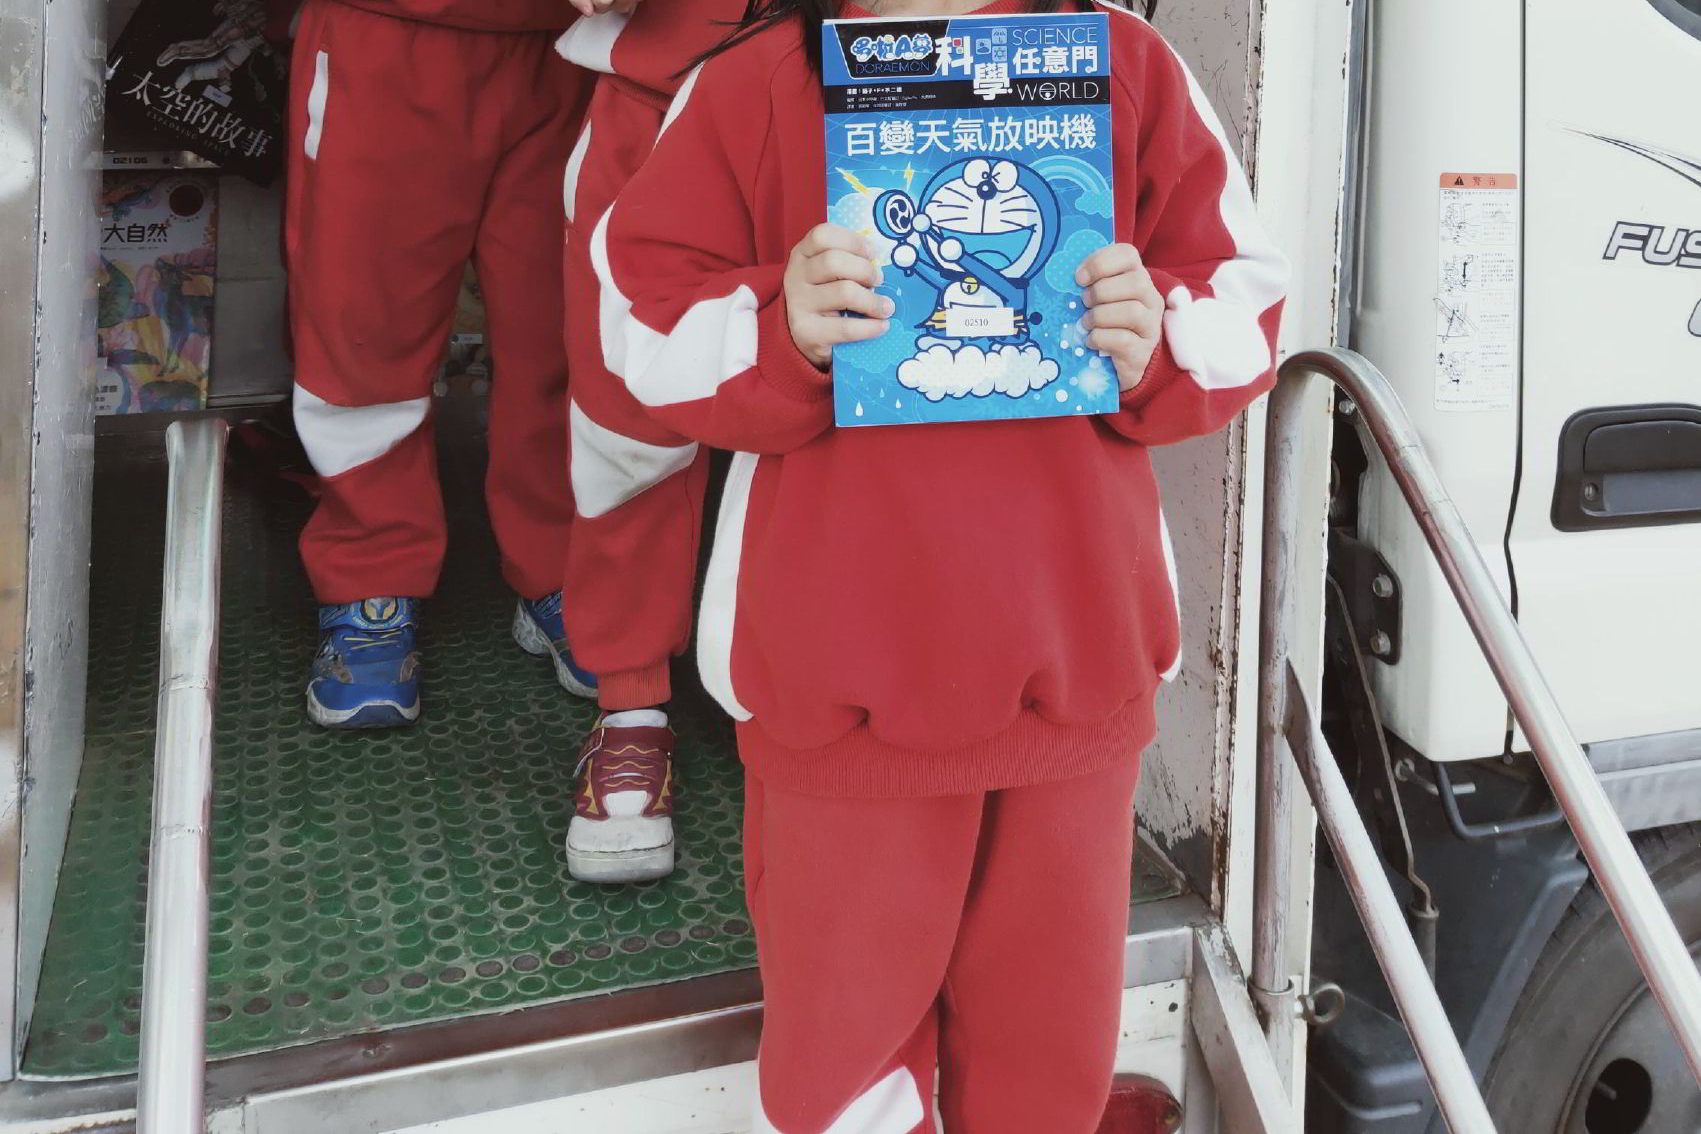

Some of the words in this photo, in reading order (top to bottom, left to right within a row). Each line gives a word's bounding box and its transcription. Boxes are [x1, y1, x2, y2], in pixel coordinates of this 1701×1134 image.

[1012, 27, 1098, 46] SCIENCE
[855, 60, 930, 75] DORAEMON
[1012, 45, 1098, 75] 任意門
[1016, 81, 1099, 102] WORLD
[120, 71, 273, 158] 太空的故事
[844, 113, 1097, 157] 百變天氣放映機
[1473, 177, 1496, 186] 警告
[103, 223, 169, 243] 大自然
[964, 318, 989, 327] 02510
